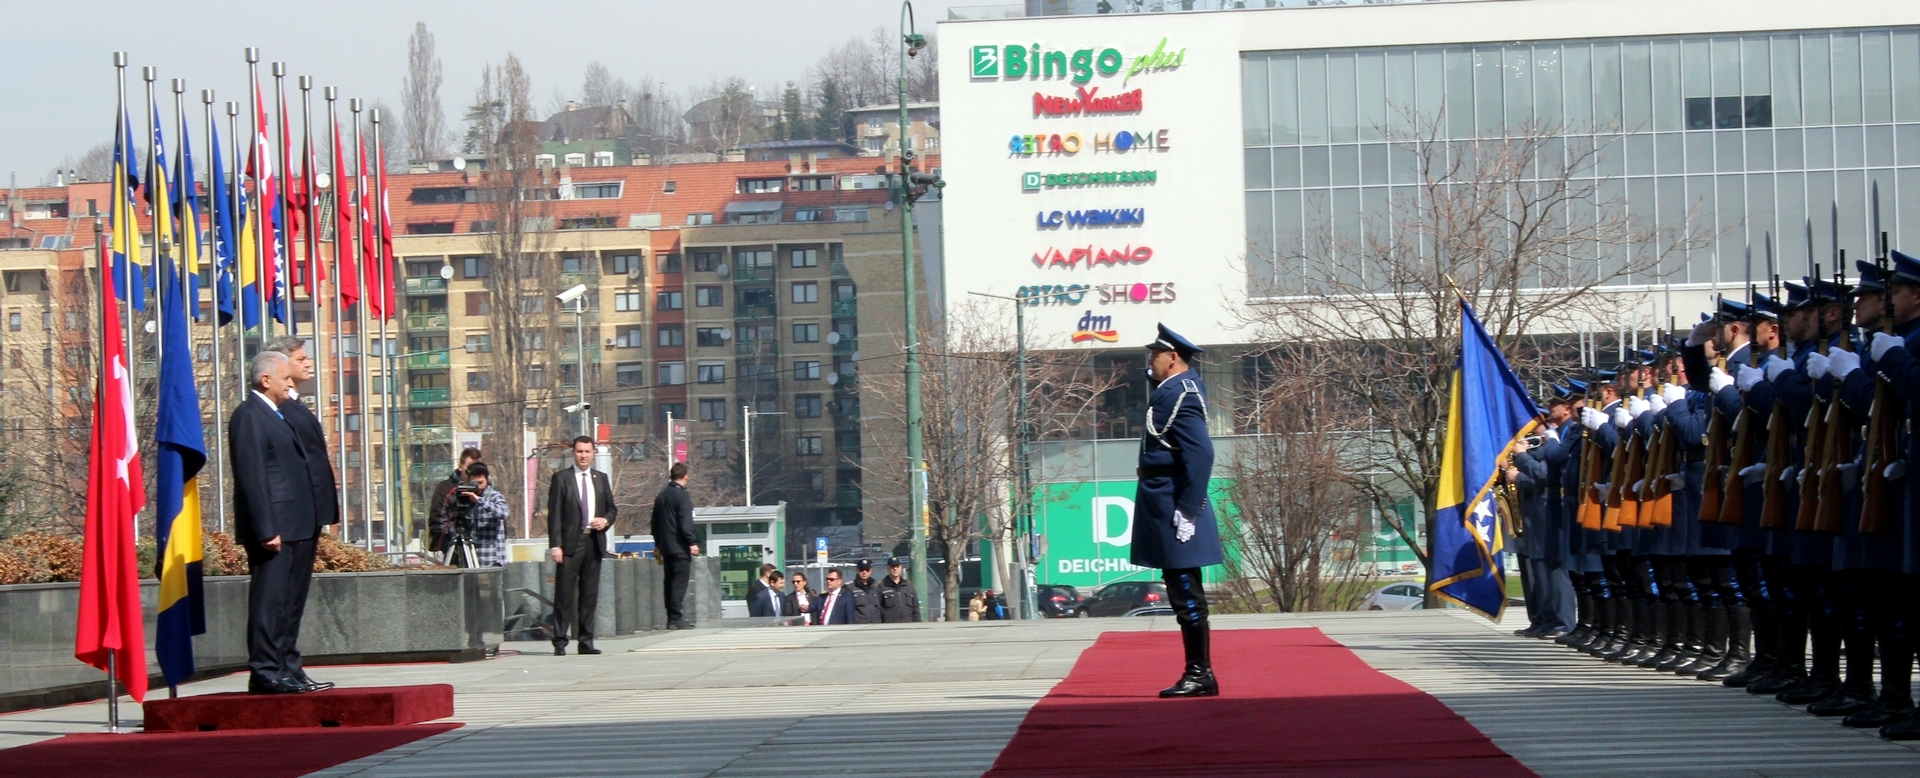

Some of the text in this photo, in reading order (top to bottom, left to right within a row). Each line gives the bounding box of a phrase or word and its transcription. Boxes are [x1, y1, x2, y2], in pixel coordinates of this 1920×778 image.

[1005, 43, 1123, 83] Bingo
[1125, 37, 1186, 82] plus
[1096, 129, 1170, 151] HOME
[1046, 170, 1157, 187] DEICHMANN
[1039, 211, 1063, 228] LC
[1034, 244, 1153, 266] VAPIANO
[1099, 282, 1176, 304] SHOES
[1077, 310, 1112, 331] dm
[1091, 496, 1135, 547] D
[1058, 557, 1156, 573] DEICHM
